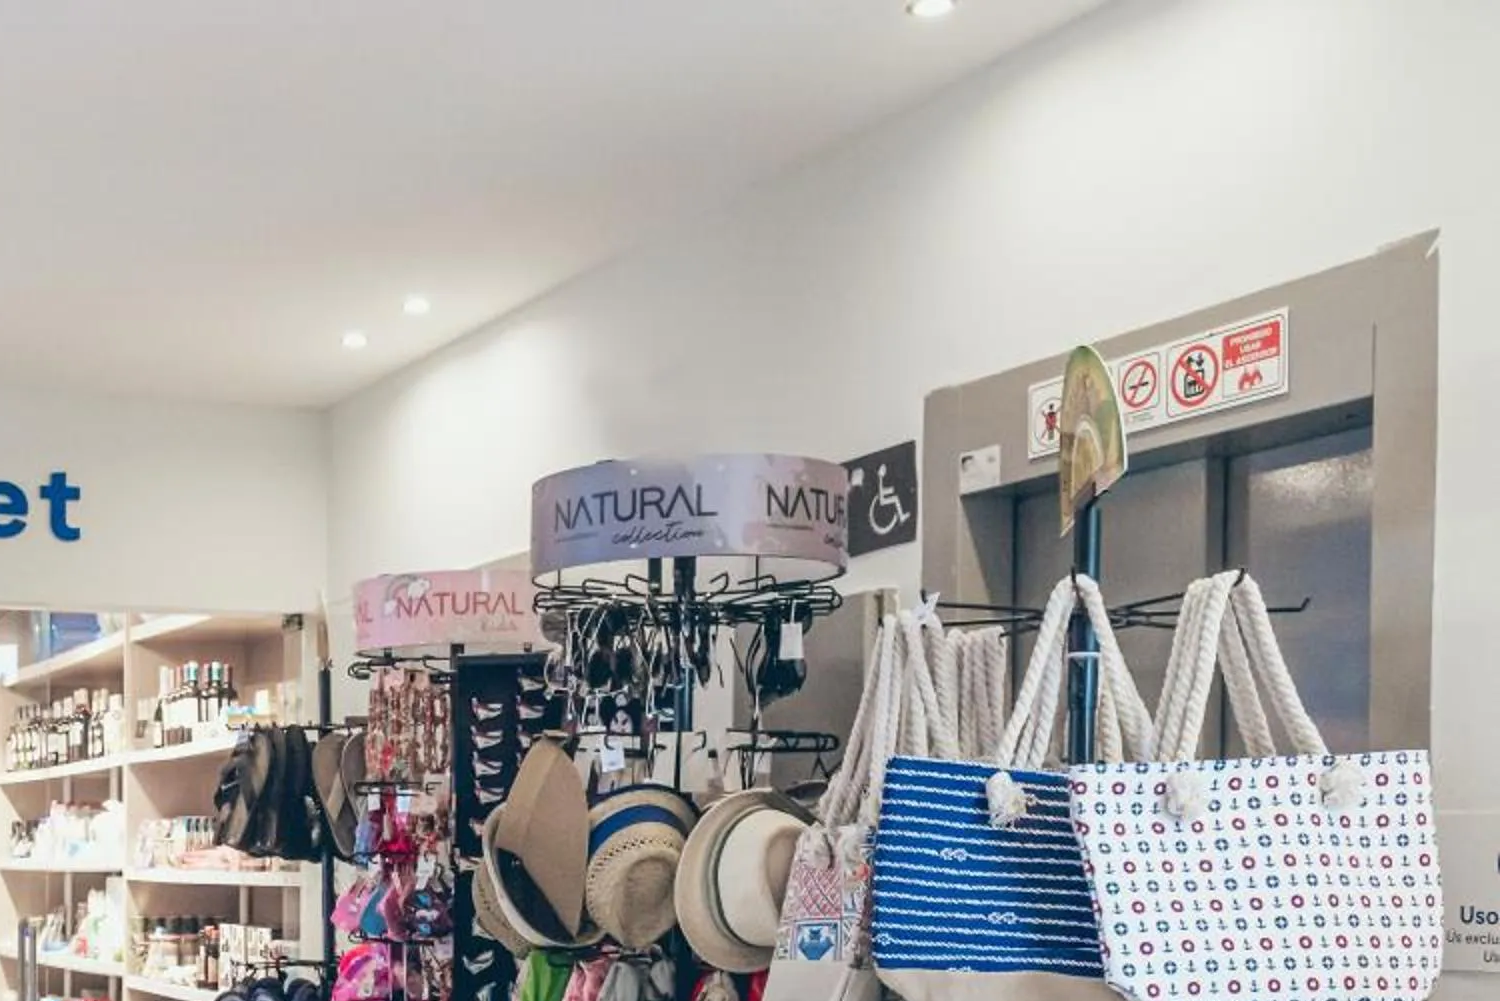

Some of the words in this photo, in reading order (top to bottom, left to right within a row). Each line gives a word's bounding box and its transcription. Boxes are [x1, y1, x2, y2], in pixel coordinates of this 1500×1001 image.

[554, 484, 718, 532] NATURAL
[396, 591, 524, 618] NATURAL
[1459, 905, 1499, 925] Uso
